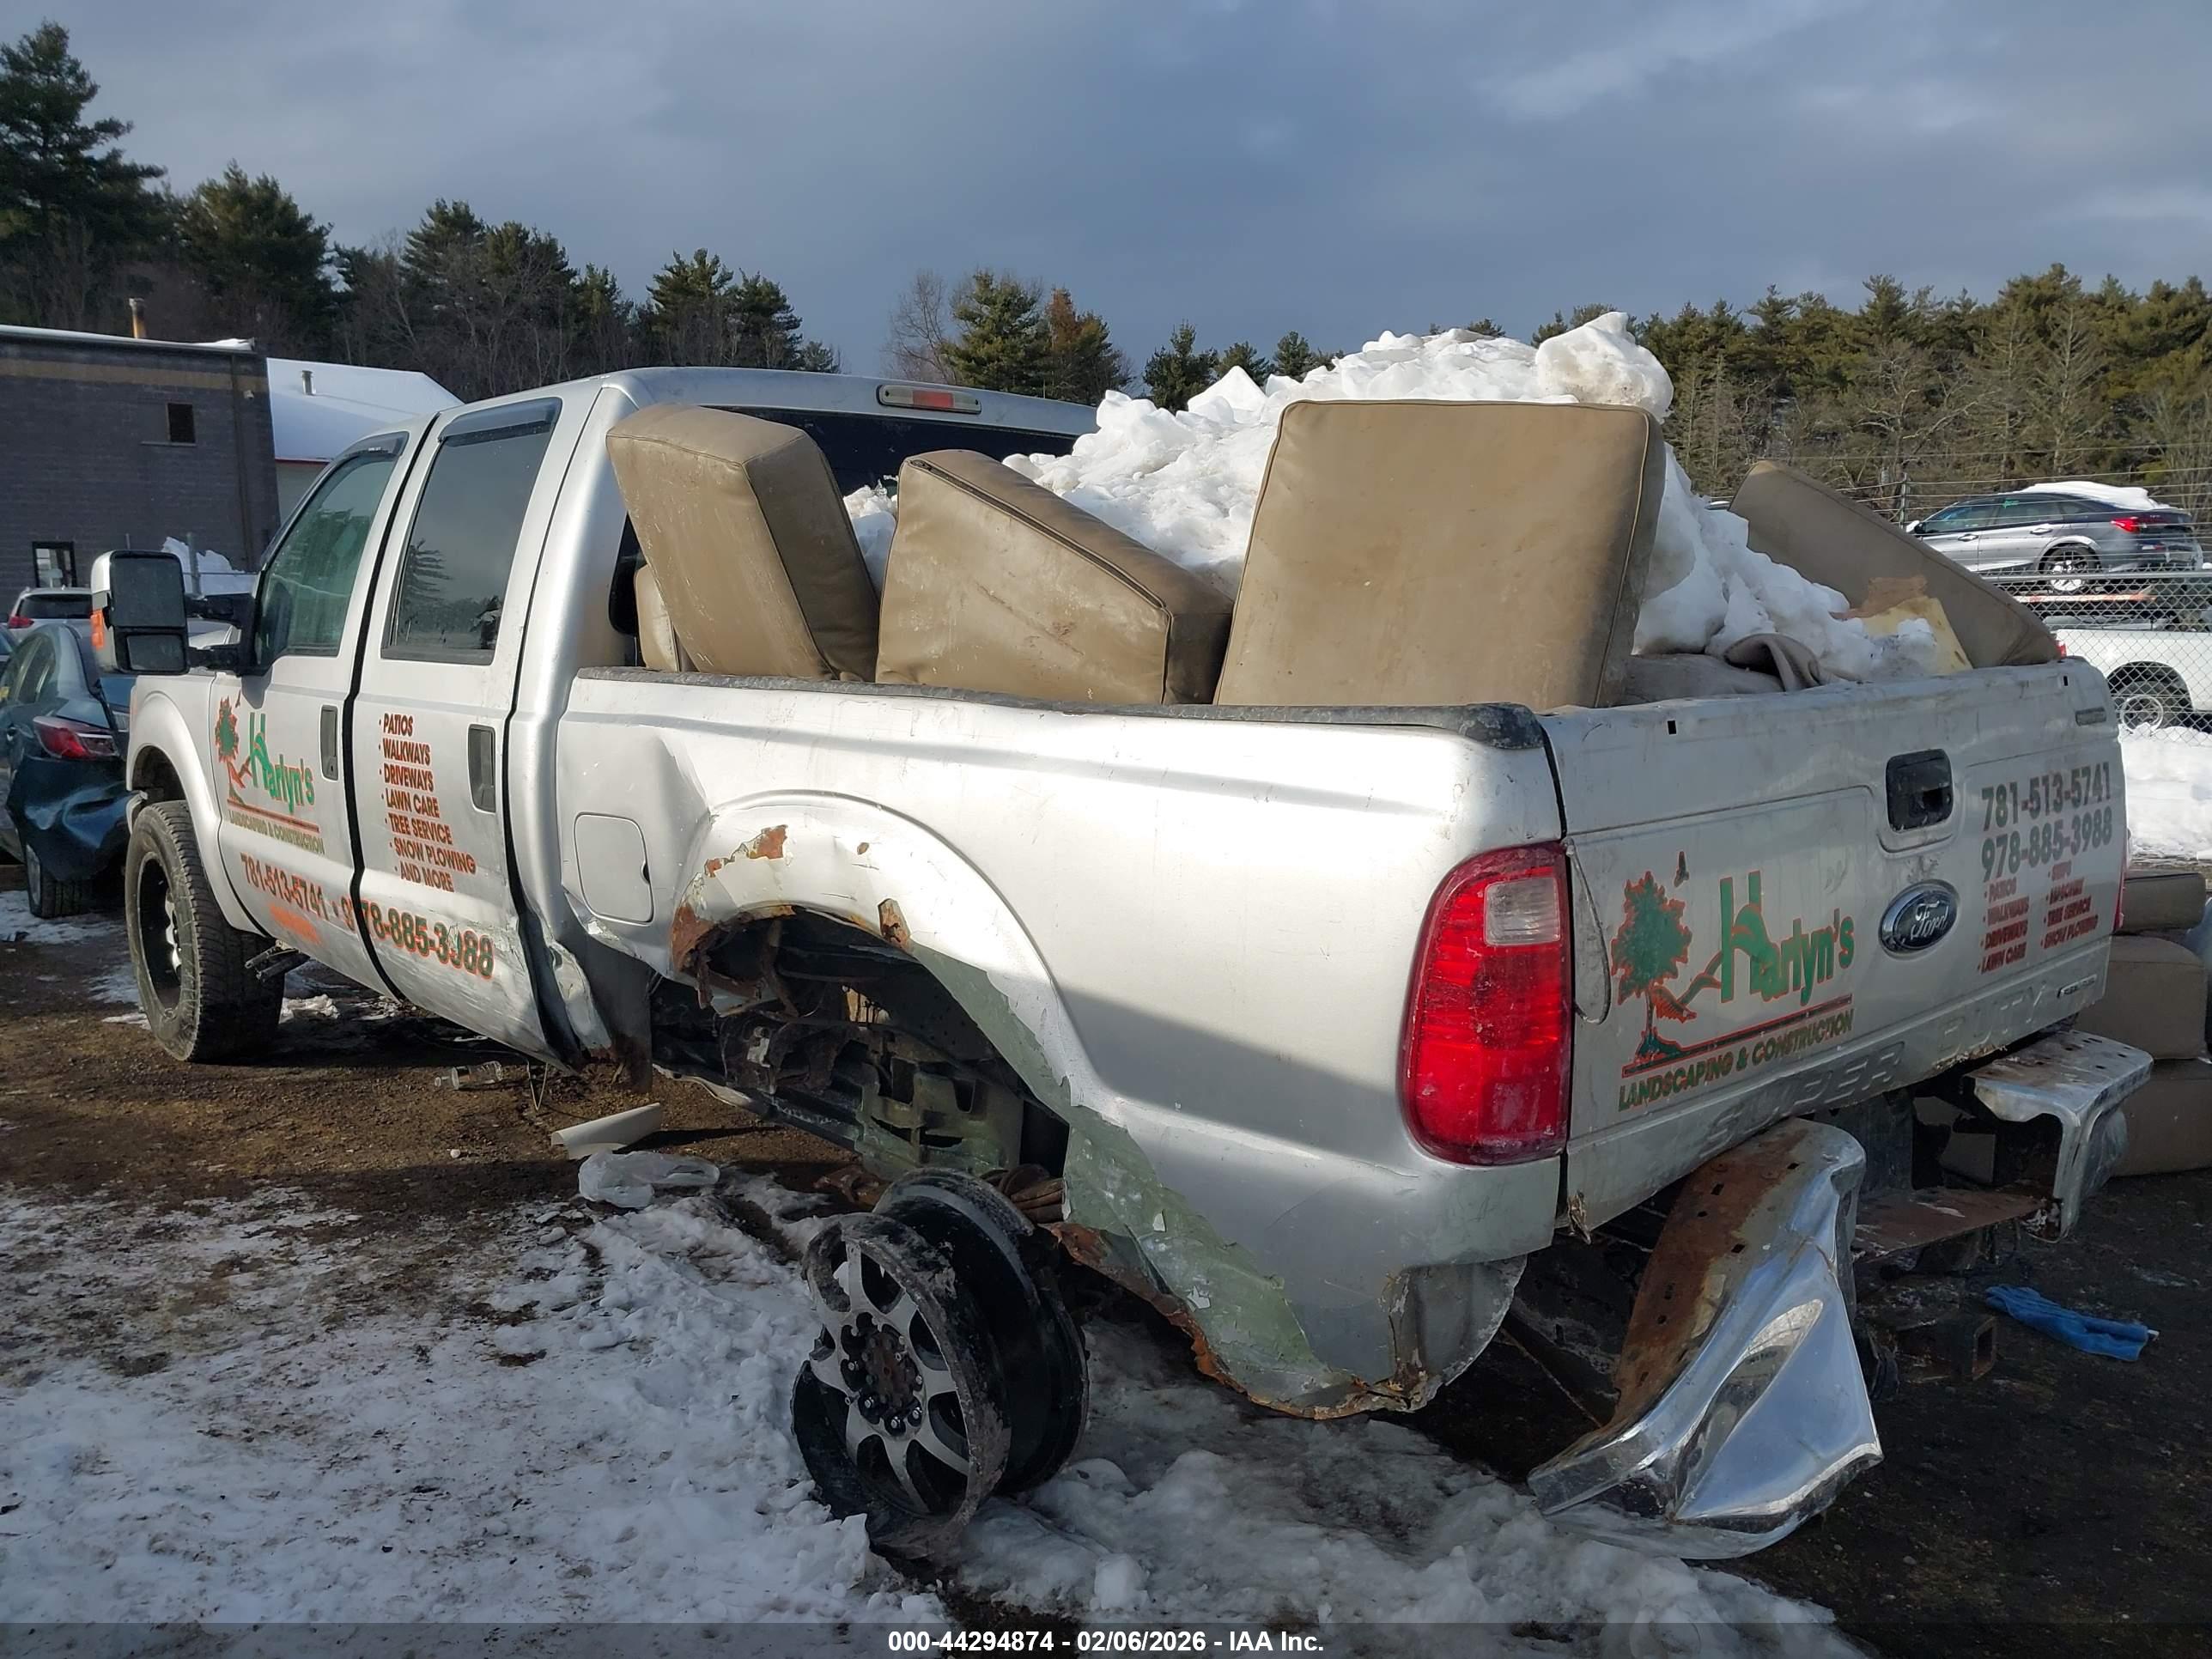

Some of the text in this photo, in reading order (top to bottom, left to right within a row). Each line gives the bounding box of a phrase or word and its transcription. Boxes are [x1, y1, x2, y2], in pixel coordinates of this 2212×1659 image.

[383, 713, 414, 737] PATIOS
[383, 738, 431, 766] WALKWAYS
[383, 763, 434, 792] DRIVEWAYS
[386, 787, 441, 818] LAWN CARE
[1981, 762, 2111, 831] 781-513-5741
[388, 812, 453, 845] TREE SERVICE
[1981, 806, 2112, 882] 978-885-3988
[394, 837, 477, 874] SNOW PLOWING
[240, 852, 329, 921] 781-513-5741
[400, 860, 455, 893] AND MORE
[1720, 870, 1855, 1006] Harlyn's
[1911, 900, 1950, 940] Ford
[1619, 1008, 1854, 1111] LANDSCAPING & CONSTRUCTION
